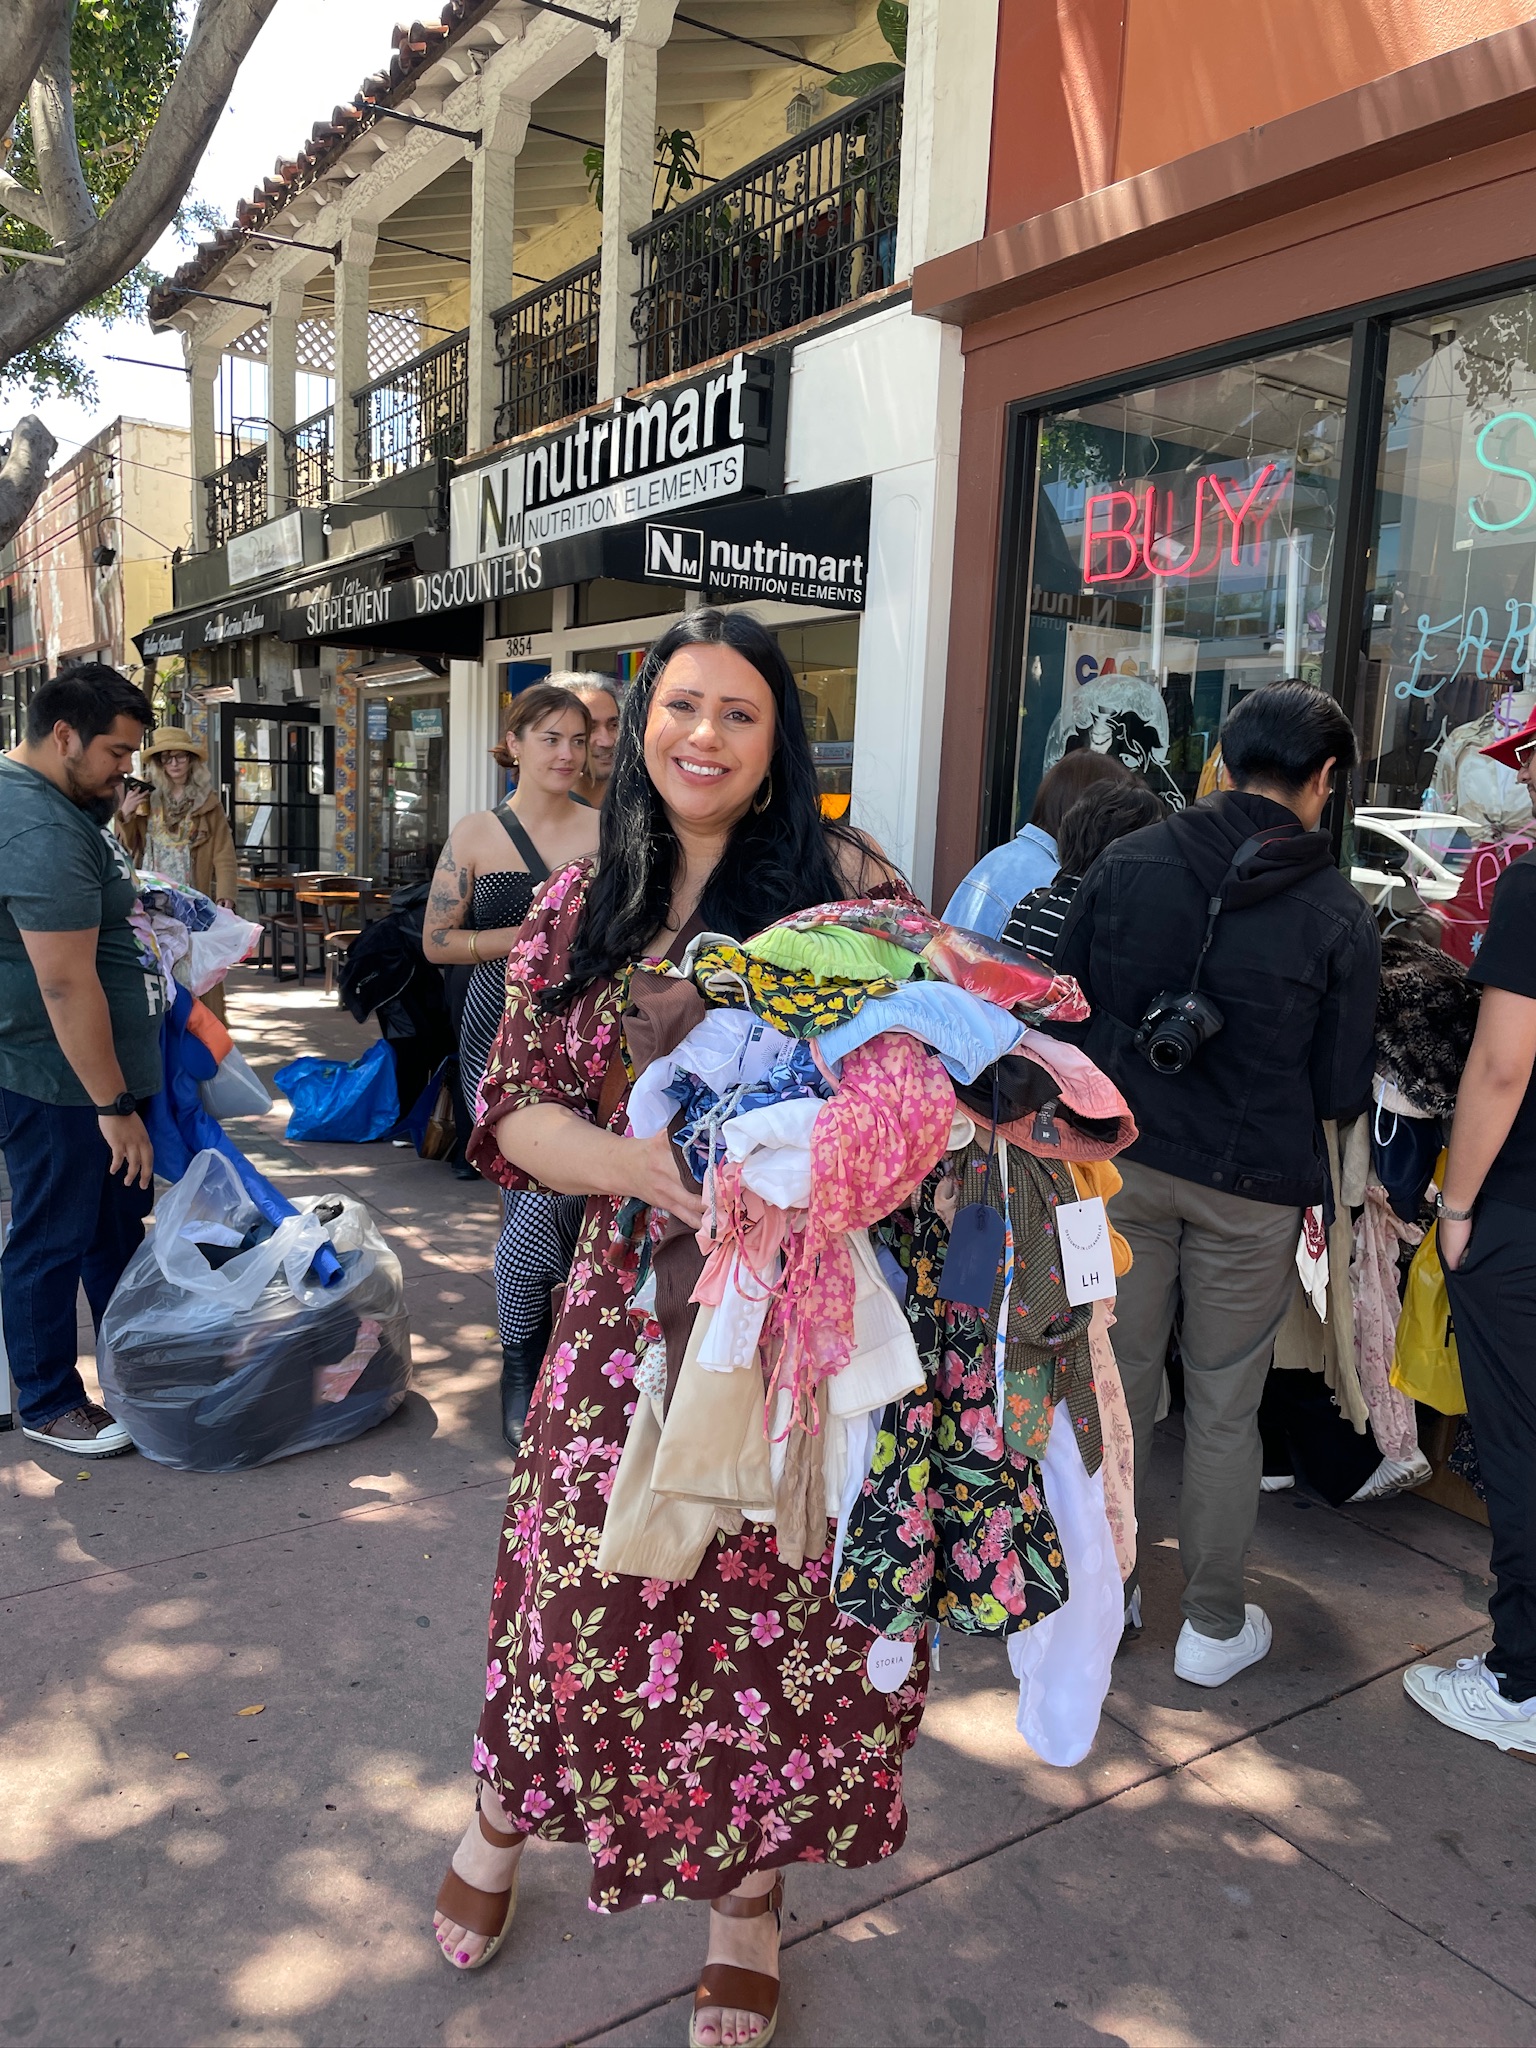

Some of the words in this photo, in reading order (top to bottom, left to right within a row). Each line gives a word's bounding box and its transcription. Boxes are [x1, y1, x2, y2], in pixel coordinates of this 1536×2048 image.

[526, 353, 747, 505] nutrimart
[527, 494, 617, 541] NUTRITION
[624, 457, 738, 513] ELEMENTS
[1083, 463, 1277, 584] BUY
[709, 540, 864, 586] nutrimart
[306, 586, 392, 636] SUPPLEMENT
[415, 547, 543, 615] DISCOUNTERS
[708, 571, 788, 595] NUTRITION
[790, 582, 863, 604] ELEMENTS
[506, 636, 533, 658] 3854
[414, 726, 442, 736] CLOSED
[1081, 1271, 1100, 1288] LH
[875, 1656, 904, 1669] STORIA
